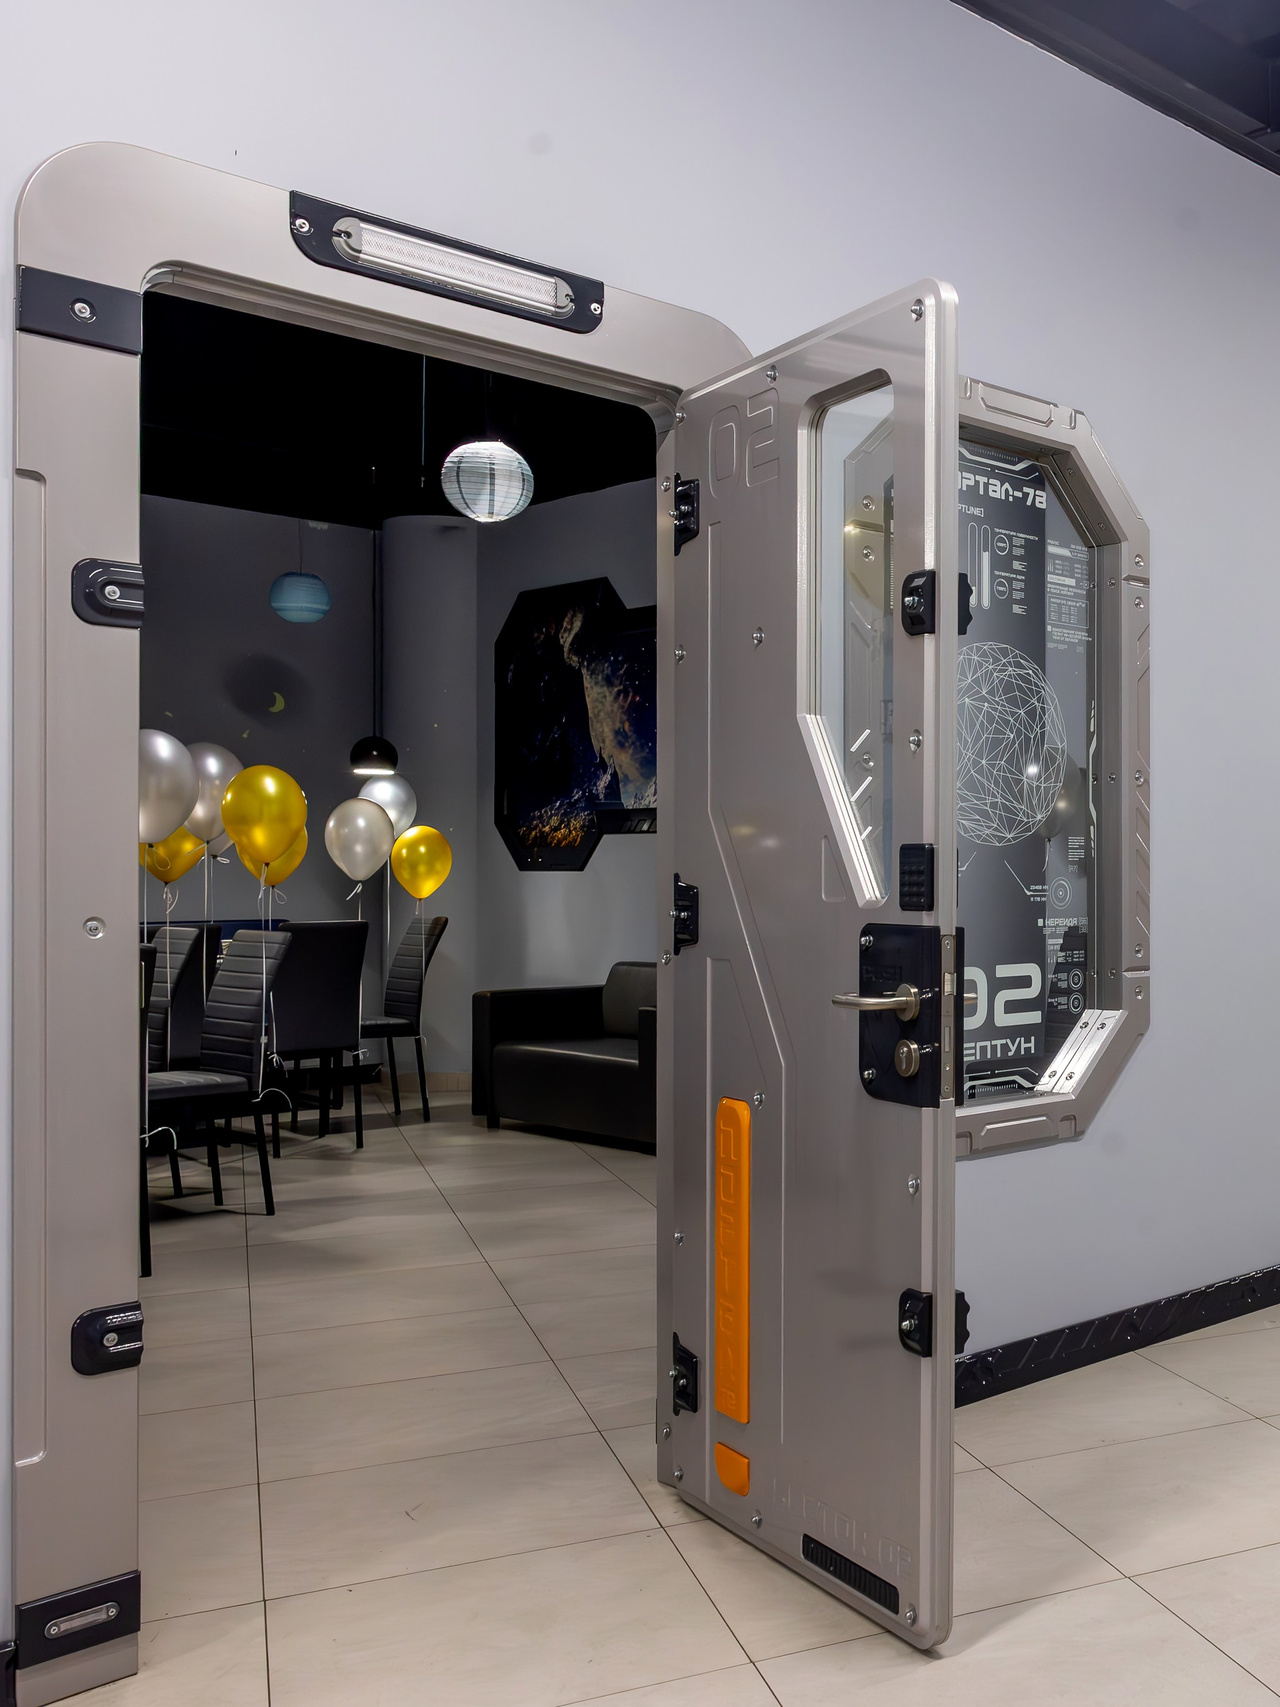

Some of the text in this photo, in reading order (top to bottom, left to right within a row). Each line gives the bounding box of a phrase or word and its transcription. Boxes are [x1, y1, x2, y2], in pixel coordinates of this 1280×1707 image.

[708, 387, 781, 499] 02
[958, 471, 1047, 509] РТАЛ-78
[1045, 917, 1078, 927] НЕРЕИДА
